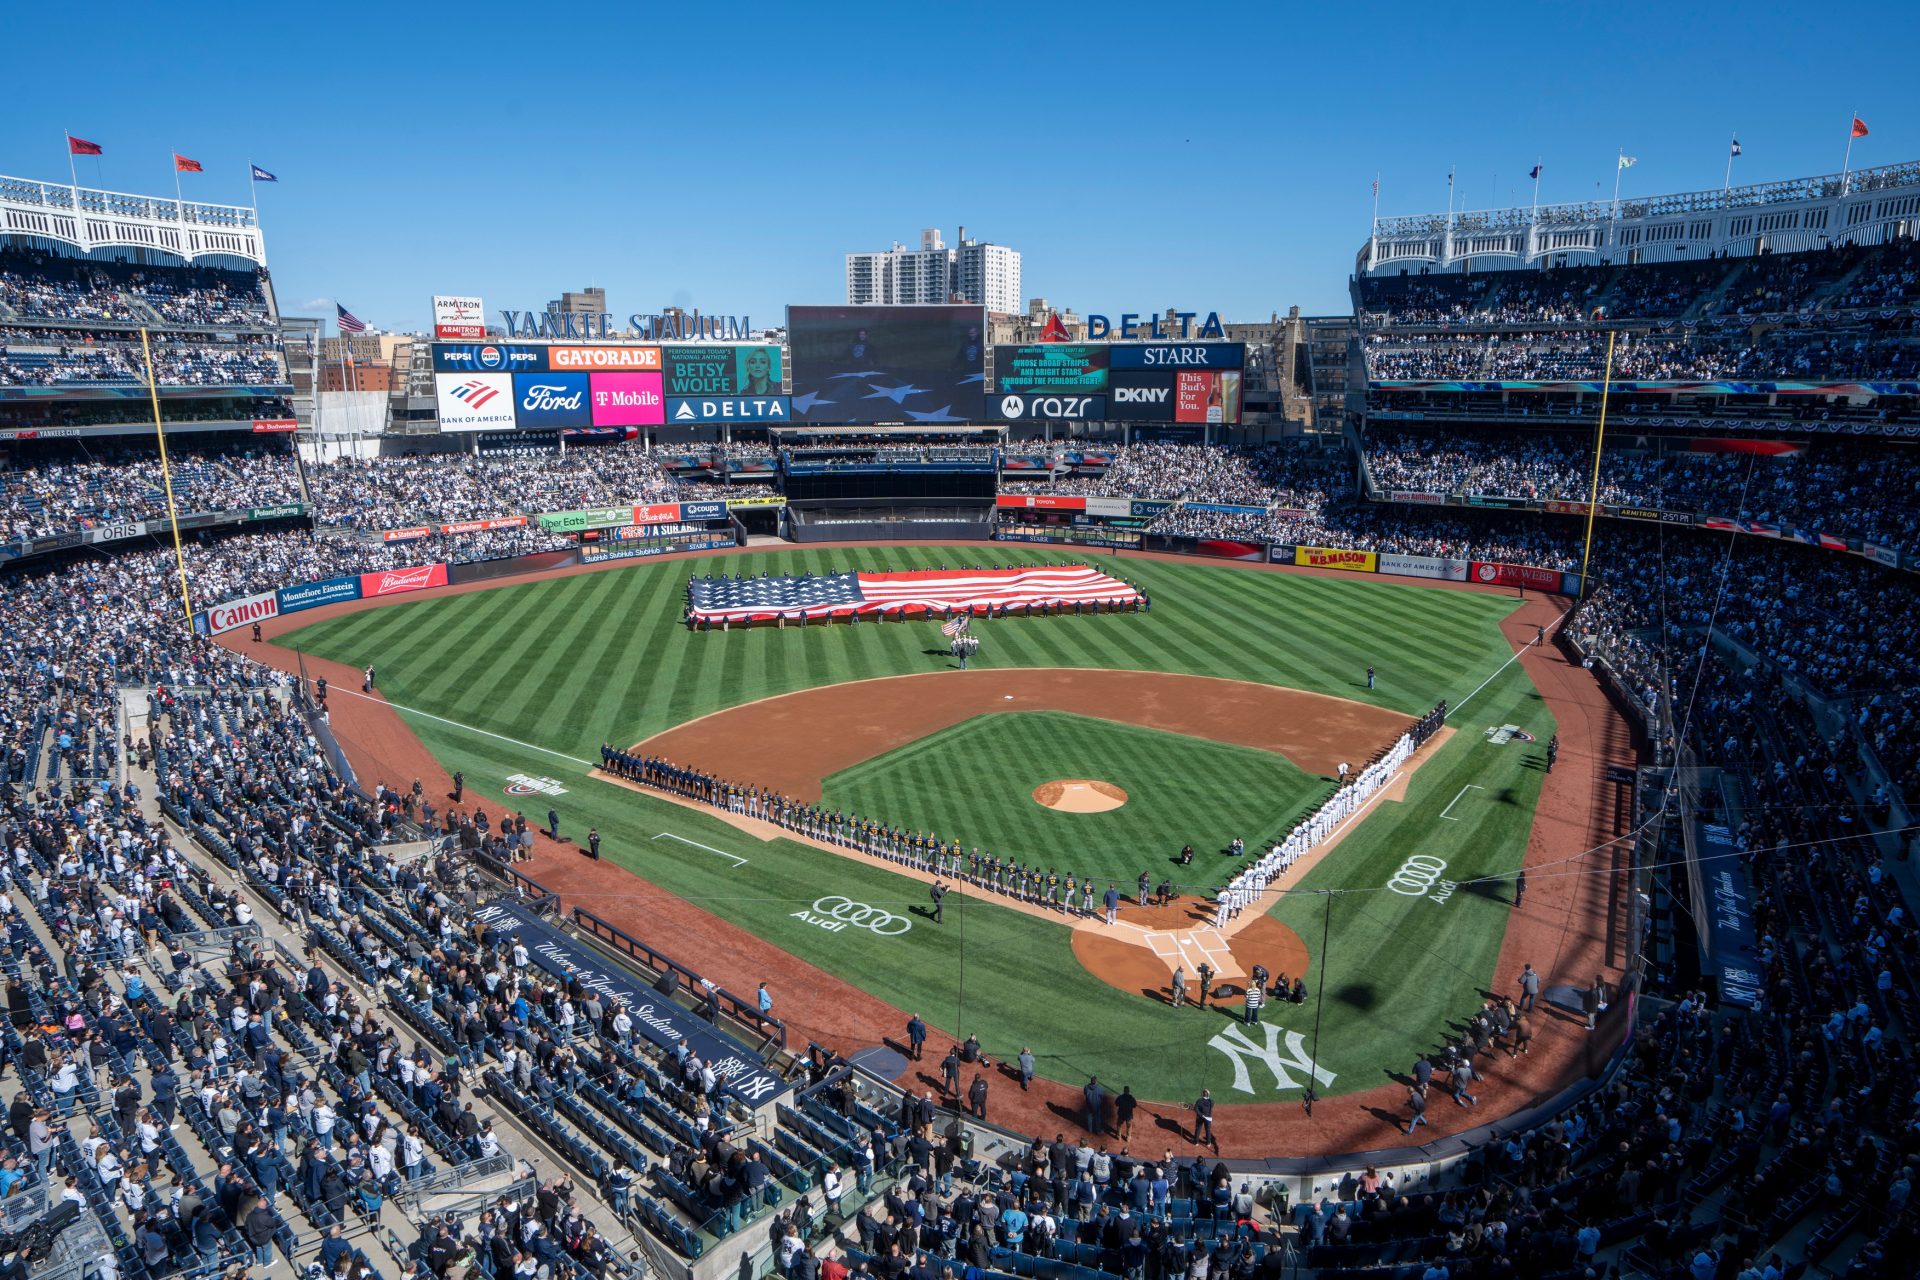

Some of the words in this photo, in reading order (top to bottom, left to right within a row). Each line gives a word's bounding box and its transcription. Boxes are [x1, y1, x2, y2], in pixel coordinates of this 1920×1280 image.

[499, 310, 616, 340] YANKEE
[630, 314, 750, 341] STADIUM
[1088, 312, 1226, 340] DELTA
[444, 353, 472, 361] PEPSI
[510, 353, 537, 361] PEPSI
[555, 350, 656, 366] GATORADE
[1013, 359, 1037, 367] WHOSE
[1039, 359, 1061, 367] BROAD
[1062, 359, 1089, 367] STRIPES
[1144, 347, 1208, 365] STARR
[676, 362, 725, 377] BETSY
[1180, 373, 1202, 381] This
[672, 377, 731, 392] WOLFE
[1180, 382, 1206, 391] Bud's
[523, 385, 582, 410] Ford
[596, 391, 608, 406] T
[611, 391, 659, 406] Mobile
[1115, 388, 1169, 402] DKNY
[1180, 392, 1196, 400] For
[703, 400, 784, 417] DELTA
[1031, 398, 1092, 417] razr
[1180, 401, 1200, 410] You.
[254, 509, 276, 518] Poland
[276, 506, 298, 516] Spring
[697, 504, 719, 513] coupa
[1621, 509, 1658, 518] ARMITRON
[564, 516, 585, 526] Eats
[1662, 513, 1679, 521] 2:57
[102, 525, 137, 539] ORIS
[652, 528, 659, 536] A
[660, 525, 681, 535] SUB
[681, 521, 708, 532] ABOVE
[585, 554, 608, 563] StubHub
[610, 551, 634, 560] StubHub
[635, 547, 660, 556] StubHub
[1328, 553, 1367, 564] MASON
[1381, 561, 1400, 569] BANK
[1414, 564, 1448, 572] AMERICA
[385, 574, 429, 588] Budweiser
[1498, 566, 1519, 577] F.W.
[1521, 568, 1553, 582] WEBB
[282, 588, 321, 602] Montefiore
[322, 582, 354, 594] Einstein
[210, 597, 276, 631] Canon
[1428, 879, 1457, 905] Audi
[789, 910, 847, 933] Audi
[577, 971, 594, 980] to
[628, 1004, 683, 1040] Stadium
[737, 1076, 776, 1100] NY
